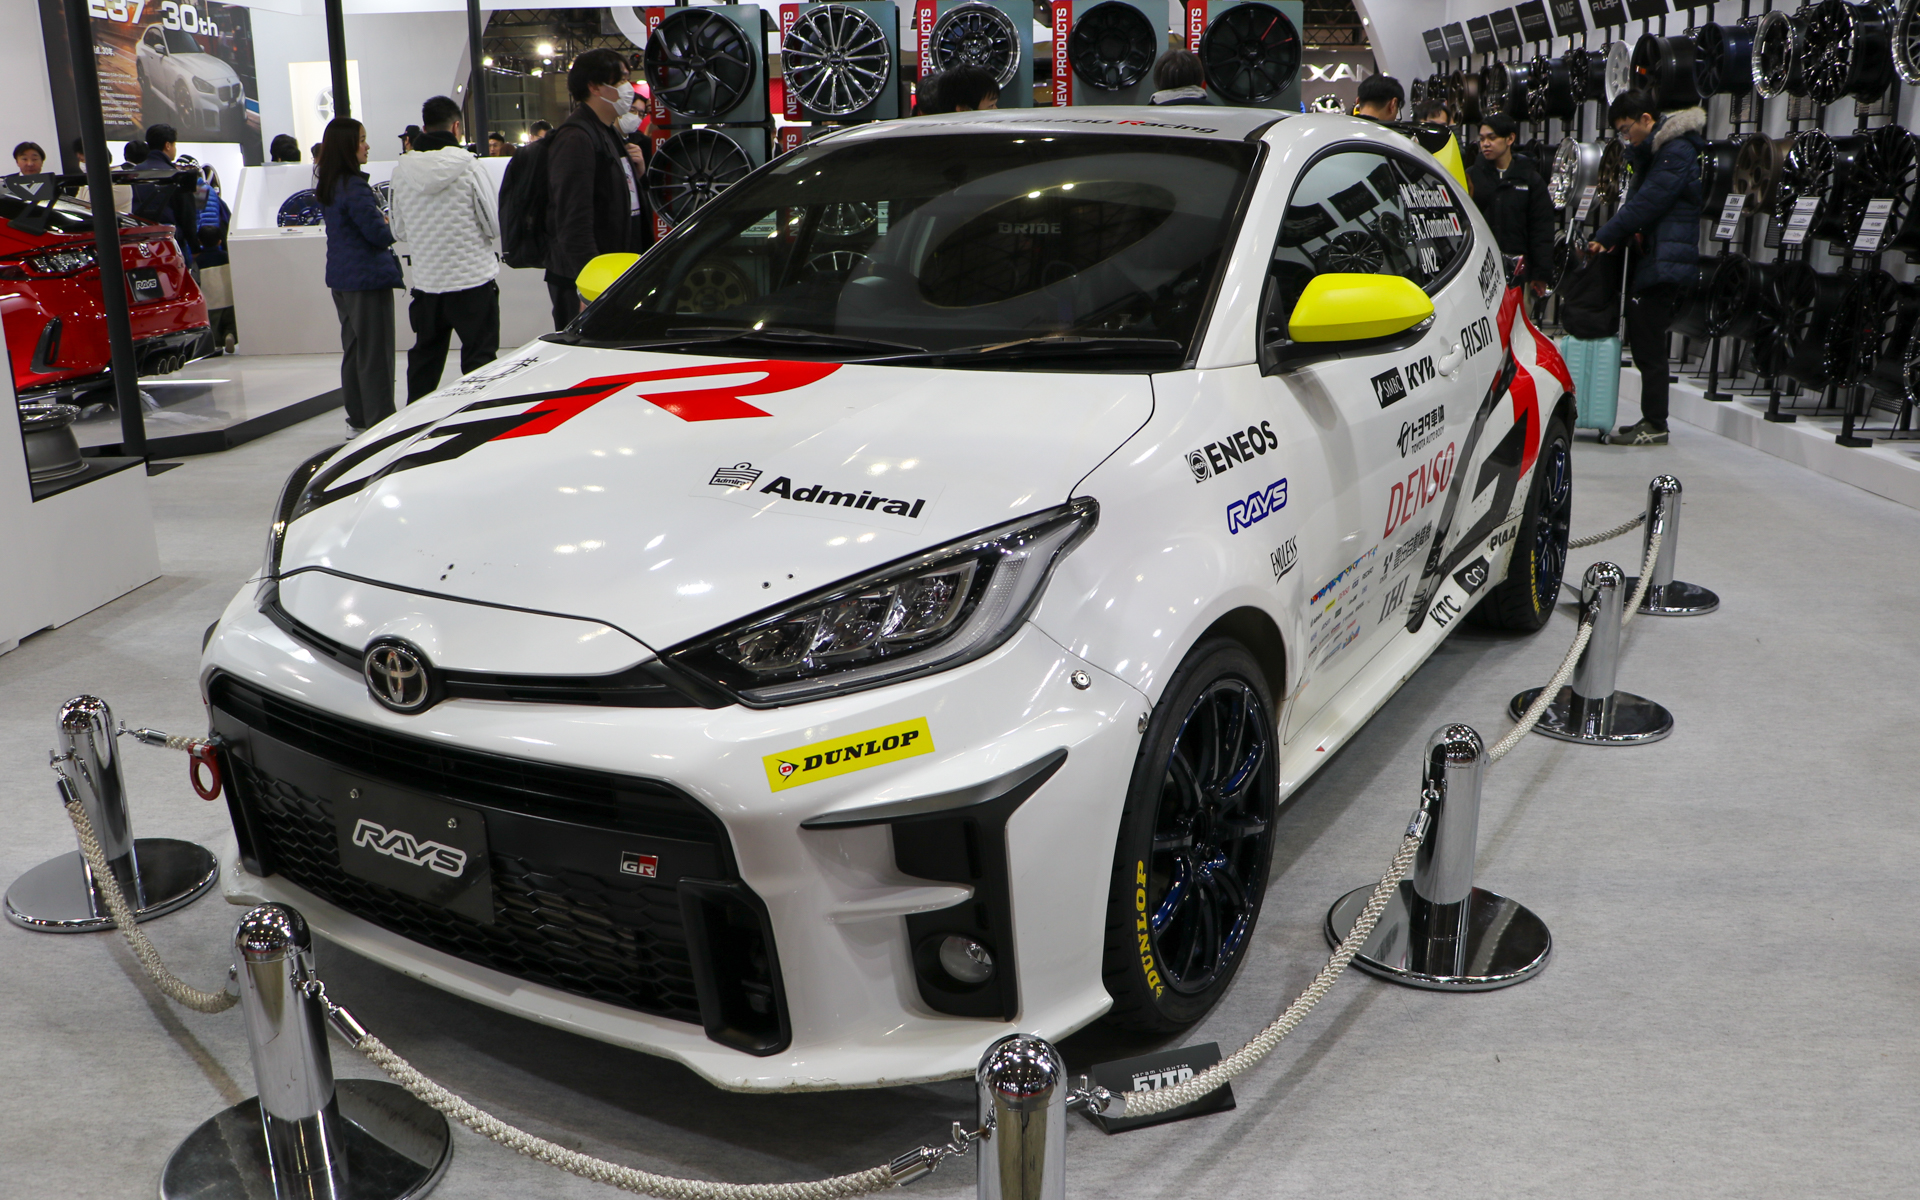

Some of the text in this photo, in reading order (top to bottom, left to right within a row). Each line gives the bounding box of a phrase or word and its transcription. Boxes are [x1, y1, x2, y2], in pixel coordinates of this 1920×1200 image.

[161, 0, 219, 37] 30th
[1191, 7, 1202, 54] DUCTS
[920, 8, 931, 77] PRODUCTS
[1056, 7, 1067, 77] PRODUCTS
[655, 98, 666, 119] NE
[1117, 119, 1219, 134] Racing
[657, 218, 667, 237] NE
[998, 222, 1062, 234] BRIDE
[1421, 246, 1440, 274] JN2
[136, 278, 158, 290] RAYS
[1460, 316, 1493, 360] AISIN
[1383, 374, 1404, 398] SMBC
[1404, 355, 1436, 391] KYB
[1203, 420, 1279, 476] ENEOS
[760, 476, 926, 518] Admiral
[1227, 478, 1287, 535] RAYS
[1383, 441, 1455, 540] DENSO
[1270, 535, 1298, 577] ENDLESS
[1489, 525, 1517, 552] PIAA
[1378, 574, 1411, 625] IHI
[1429, 595, 1462, 628] KTC
[802, 730, 919, 772] DUNLOP
[353, 819, 467, 877] RAYS
[622, 859, 656, 876] GR
[1136, 860, 1160, 990] DUNLOP
